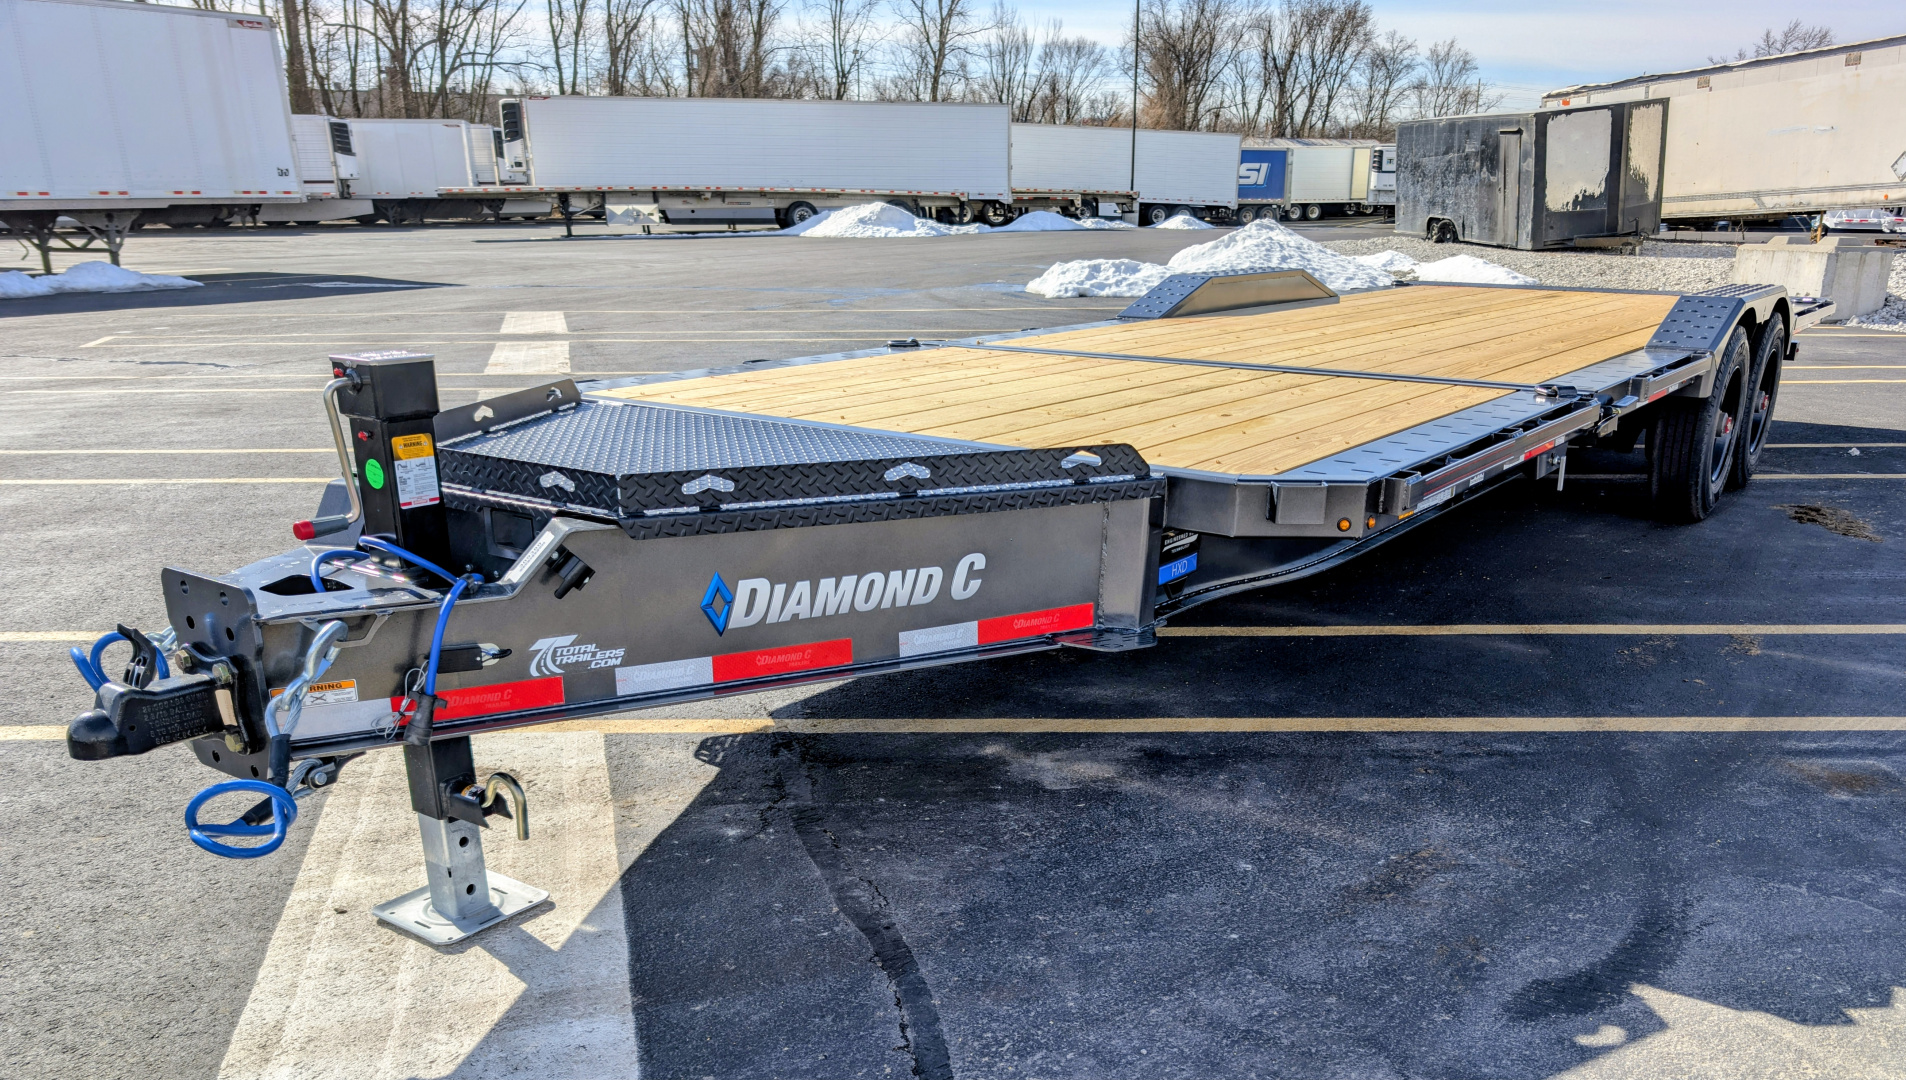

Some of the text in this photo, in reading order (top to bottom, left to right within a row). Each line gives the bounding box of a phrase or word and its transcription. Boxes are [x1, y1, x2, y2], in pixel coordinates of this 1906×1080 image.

[403, 440, 423, 448] WARNING
[1172, 560, 1188, 578] HXD
[728, 552, 986, 630] DIAMOND C
[1017, 616, 1053, 629] DIAMOND
[554, 648, 626, 665] TRAILERS
[556, 643, 600, 656] TOTAL
[587, 657, 622, 669] .COM
[760, 649, 812, 665] DIAMOND C
[310, 682, 342, 692] RNING
[450, 689, 513, 706] DIAMOND C
